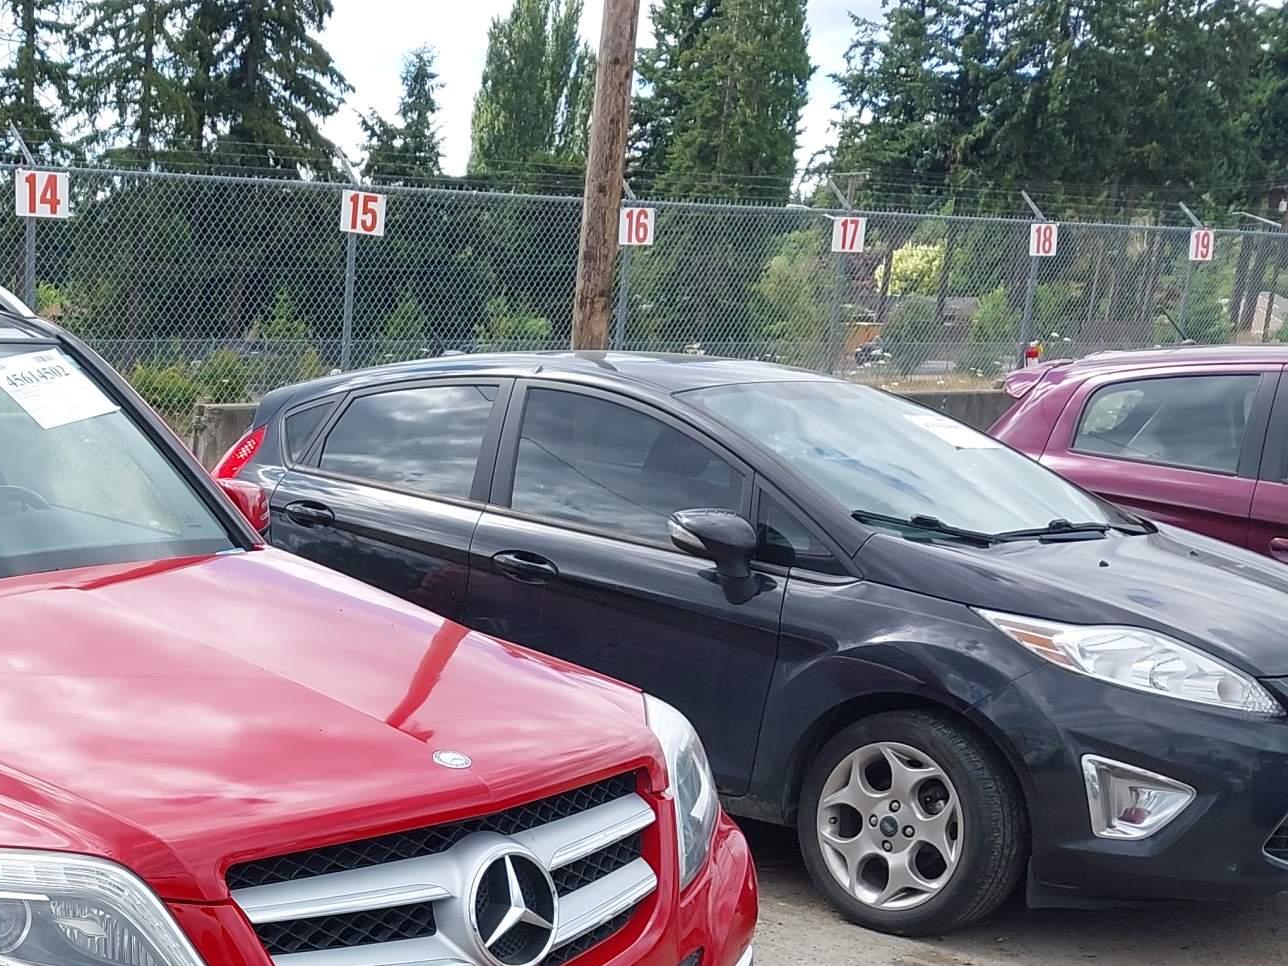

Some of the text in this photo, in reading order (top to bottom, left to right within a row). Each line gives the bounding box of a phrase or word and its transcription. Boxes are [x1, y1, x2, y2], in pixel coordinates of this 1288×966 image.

[25, 173, 60, 214] 14
[350, 193, 378, 232] 15
[626, 209, 648, 243] 16
[841, 219, 859, 250] 17
[1036, 225, 1052, 254] 18
[1195, 231, 1210, 258] 19
[6, 364, 70, 388] 45614502
